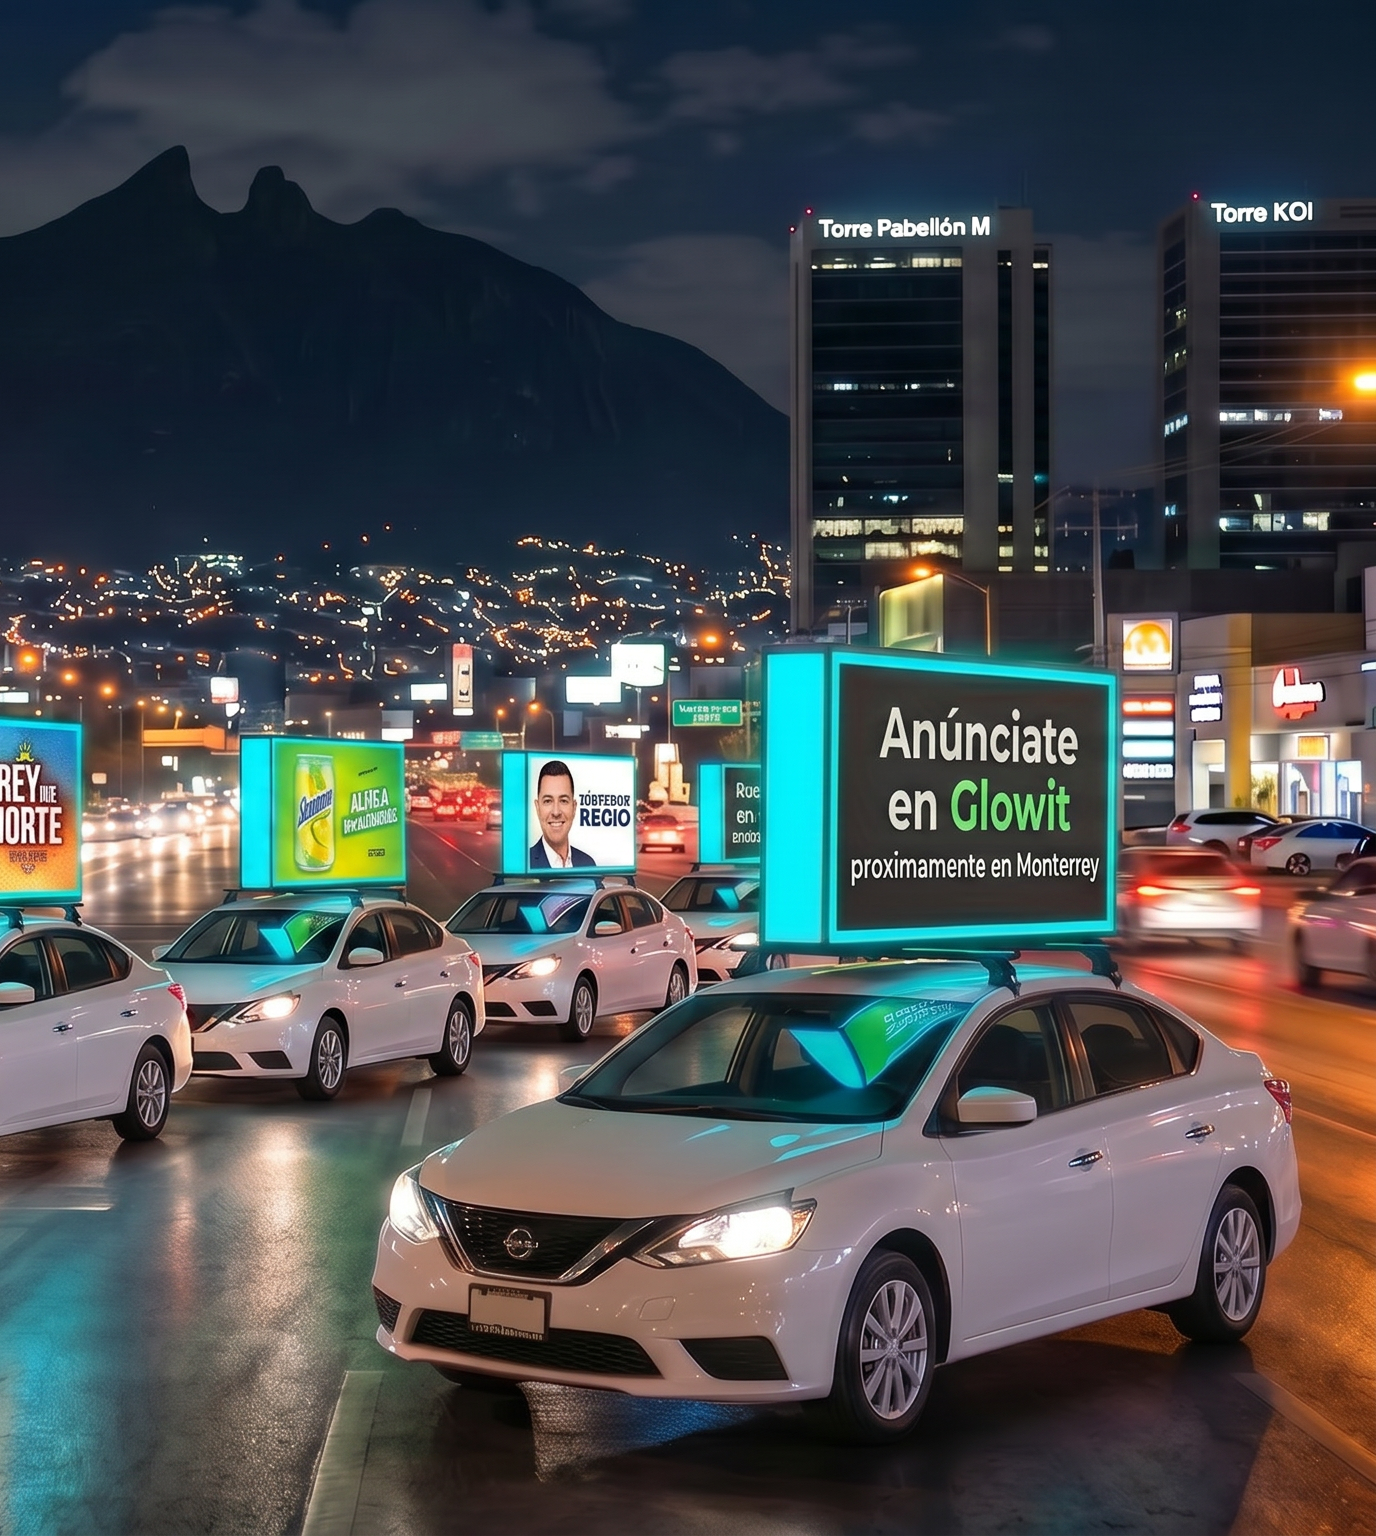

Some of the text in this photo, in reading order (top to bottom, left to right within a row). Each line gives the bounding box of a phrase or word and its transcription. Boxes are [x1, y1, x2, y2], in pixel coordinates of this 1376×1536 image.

[818, 216, 990, 238] Torre Pabellón M
[1210, 201, 1313, 223] Torre KOI
[879, 706, 1079, 765] Anúnciate
[888, 777, 1071, 832] en Glowit
[851, 850, 1100, 887] proximamente en Monterrey
